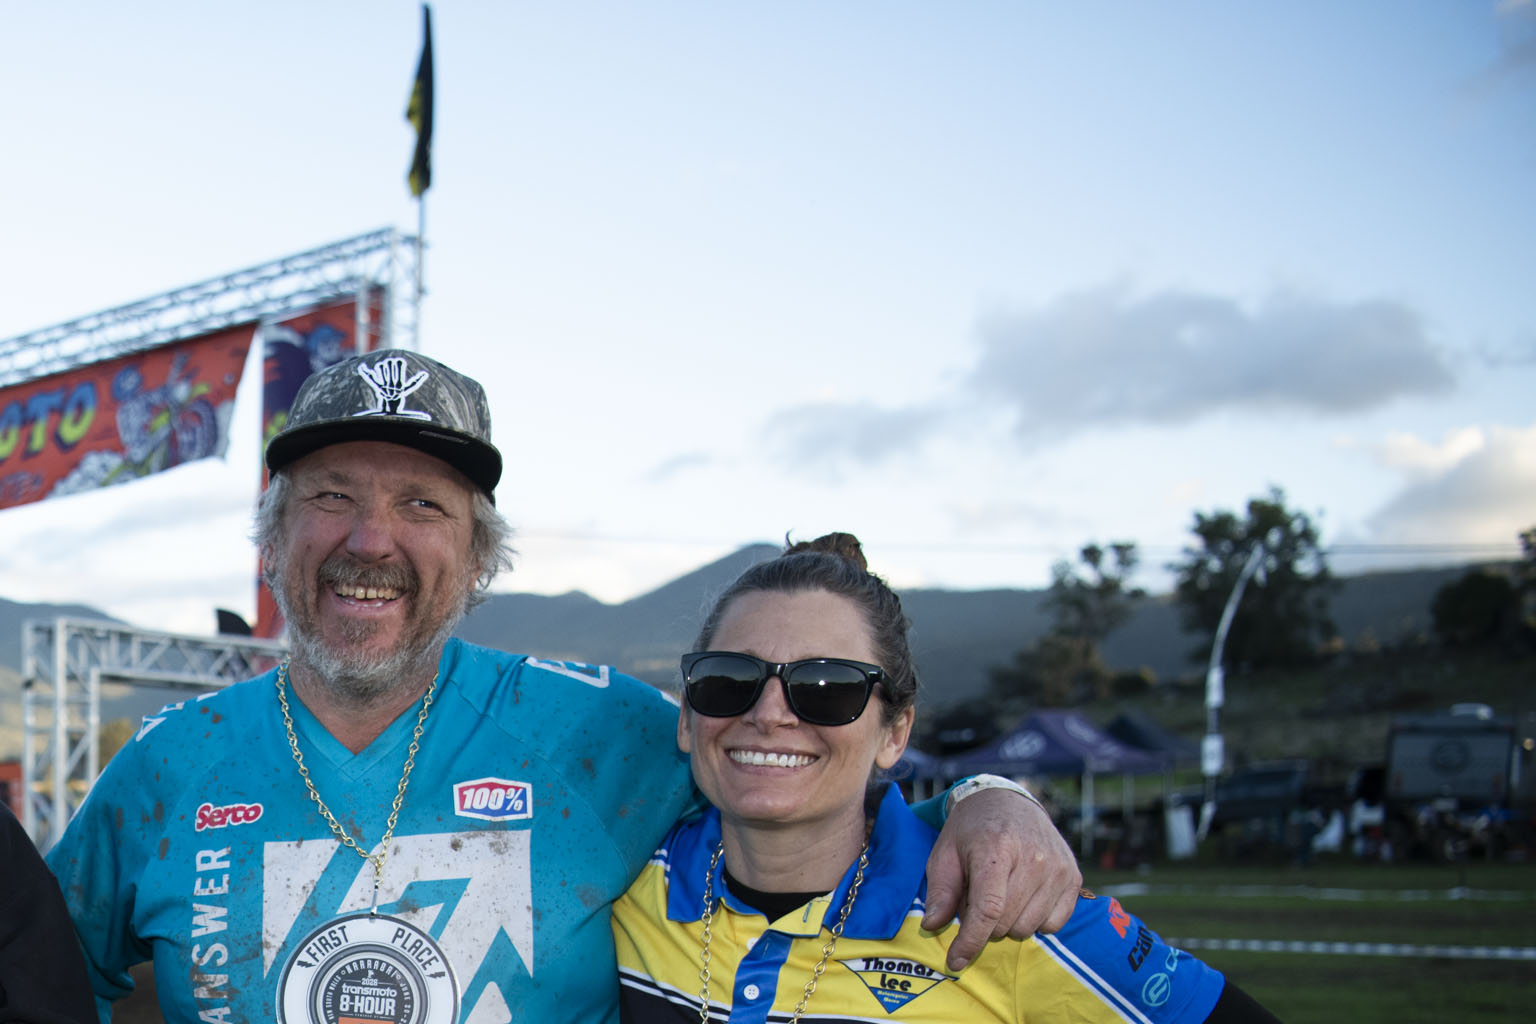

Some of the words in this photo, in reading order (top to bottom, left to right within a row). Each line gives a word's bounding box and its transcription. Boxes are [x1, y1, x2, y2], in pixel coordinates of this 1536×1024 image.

[462, 787, 524, 812] 100%
[195, 803, 263, 833] Serco
[306, 925, 350, 963] FIRST
[391, 927, 439, 971] PLACE
[342, 982, 397, 997] transmoto
[339, 994, 396, 1016] 8-HOUR
